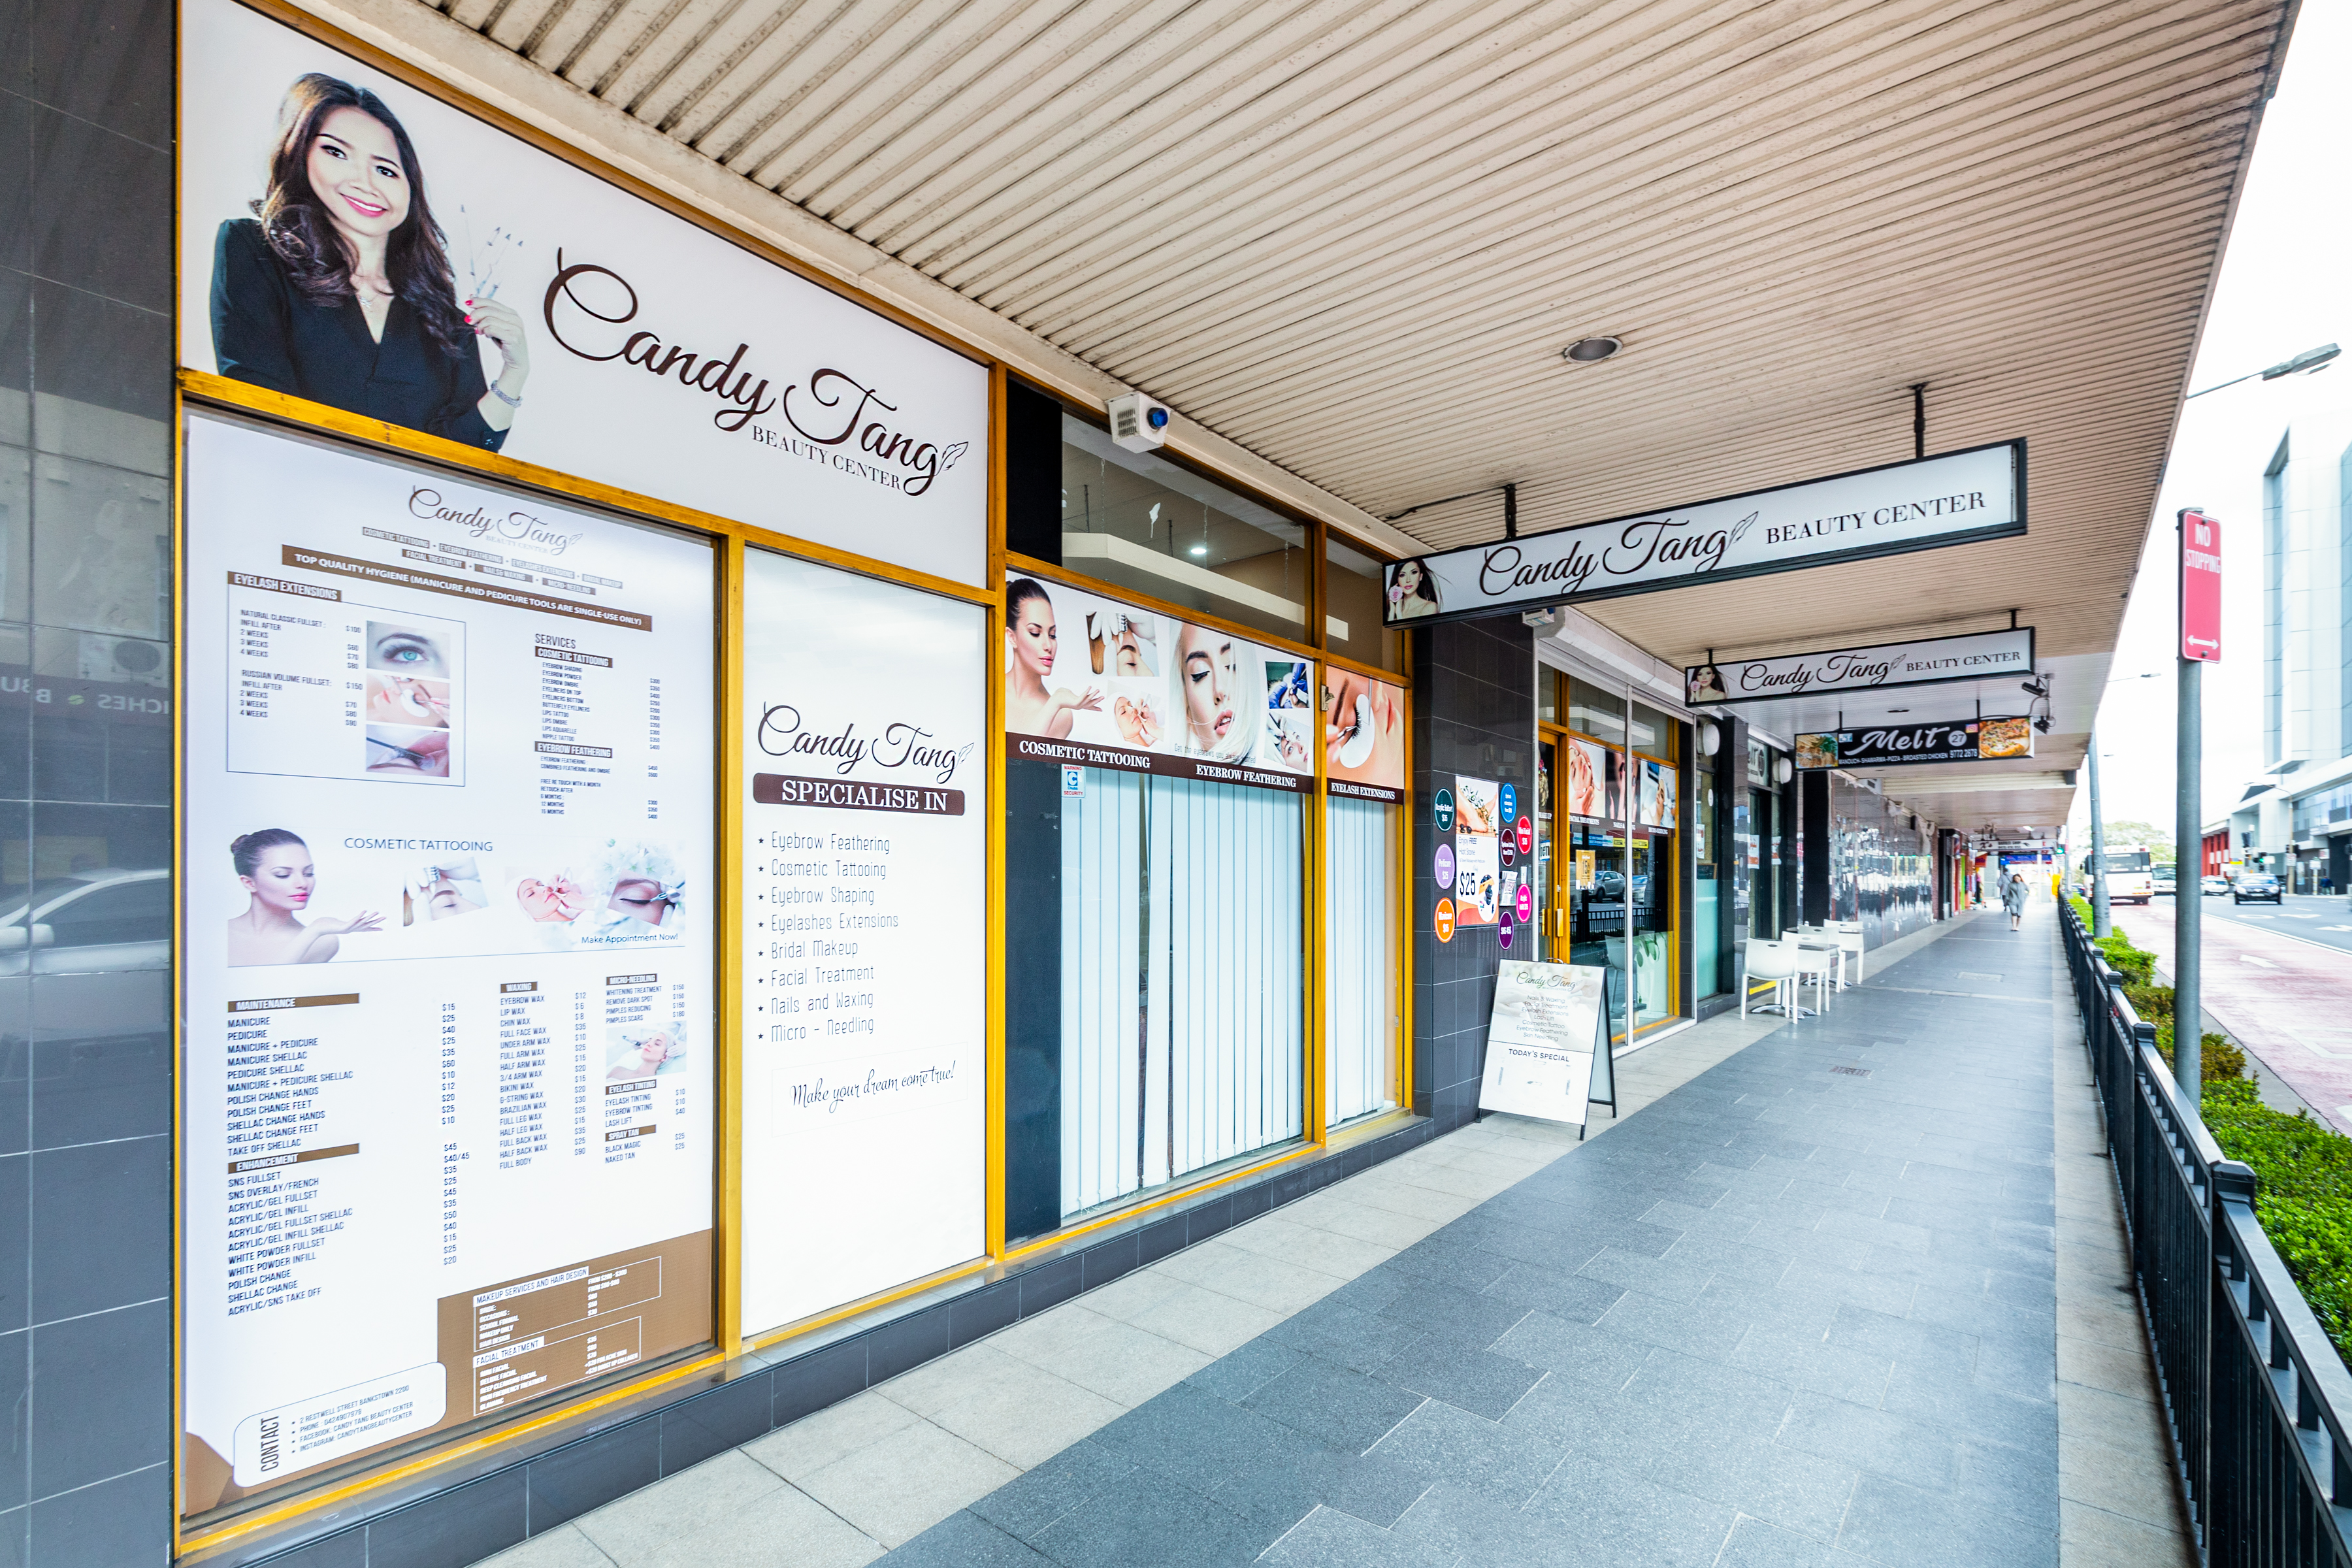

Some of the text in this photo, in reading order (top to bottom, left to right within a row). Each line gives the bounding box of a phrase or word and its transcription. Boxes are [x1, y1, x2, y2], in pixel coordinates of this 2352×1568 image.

[544, 247, 940, 496] Candy Tang
[752, 425, 901, 490] BEAUTY CENTER
[409, 485, 568, 555] Candy Tang
[486, 535, 548, 553] BEAUTY CENTER
[1479, 491, 1986, 595] Candy Tang BEAUTY CENTER
[2195, 524, 2211, 547] NO
[2186, 549, 2220, 574] STOPPING
[234, 574, 337, 600] EYELASH EXTENSIONS
[294, 554, 642, 626] TOP QUALITY HYGIENE (MANICURE AND PEDICURE TOOLS ARE SINGLE-USE ONLY)
[535, 633, 576, 649] SERVICES
[538, 647, 609, 666] COSMETIC TATTOOING
[1740, 651, 2021, 693] Candy Tang BEAUTY CENTER
[538, 743, 611, 757] EYEBROW FEATHERING
[758, 702, 959, 783] Candy Tang
[1844, 727, 1964, 755] Melt 27
[1019, 740, 1151, 768] COSMETIC TATTOOING
[1196, 764, 1296, 788] EYEBROW FEATHERING
[781, 780, 947, 811] SPECIALISE IN
[1331, 781, 1395, 800] EYELASH EXTENSIONS
[344, 838, 493, 851] COSMETIC TATTOOING
[772, 832, 890, 855] Eyebrow Feathering
[1459, 836, 1468, 845] Enjoy
[772, 858, 886, 879] Cosmetic Tattooing
[1460, 871, 1475, 897] $25
[772, 886, 874, 906] Eyebrow Shaping
[772, 913, 898, 934] Eyelashes Extensions
[581, 936, 602, 944] Make
[605, 934, 657, 944] Appointment
[772, 939, 858, 959] Bridal Makeup
[610, 975, 655, 984] MICRO-NEEDLING
[772, 966, 874, 987] Facial Treatment
[1516, 972, 1576, 991] Candy Tang
[506, 983, 532, 992] WAXING
[237, 998, 295, 1011] MAINTENANCE
[772, 991, 874, 1015] Nails and Waxing
[227, 1017, 270, 1028] MANICURE
[772, 1023, 806, 1043] Micro
[828, 1016, 874, 1037] Needling
[1540, 1028, 1568, 1036] Feathering
[227, 1030, 267, 1041] PEDICURE
[1535, 1034, 1559, 1042] Needling
[1509, 1049, 1569, 1062] TODAY'S SPECIAL
[609, 1081, 655, 1094] EYELASH TINTING
[790, 1060, 955, 1113] Make your dream come true!
[609, 1130, 628, 1140] SPRAY
[237, 1154, 299, 1171] ENHANCEMENT
[228, 1172, 281, 1187] SNS FULLSET
[477, 1269, 587, 1304] MAKEUP SERVICES AND HAIR DESIGN
[476, 1340, 539, 1365] FACIAL TREATMENT
[306, 1408, 336, 1422] RESTWELL
[337, 1401, 357, 1413] STREET
[359, 1390, 394, 1405] BANKSTOWN
[395, 1385, 409, 1394] 2200
[300, 1402, 413, 1443] FACEBOOK: CANDY TANG BEAUTY CENTER
[300, 1421, 319, 1433] PHONE
[300, 1411, 413, 1452] INSTAGRAM: CANDYTANGBEAUTYCENTER
[261, 1415, 280, 1472] CONTACT
